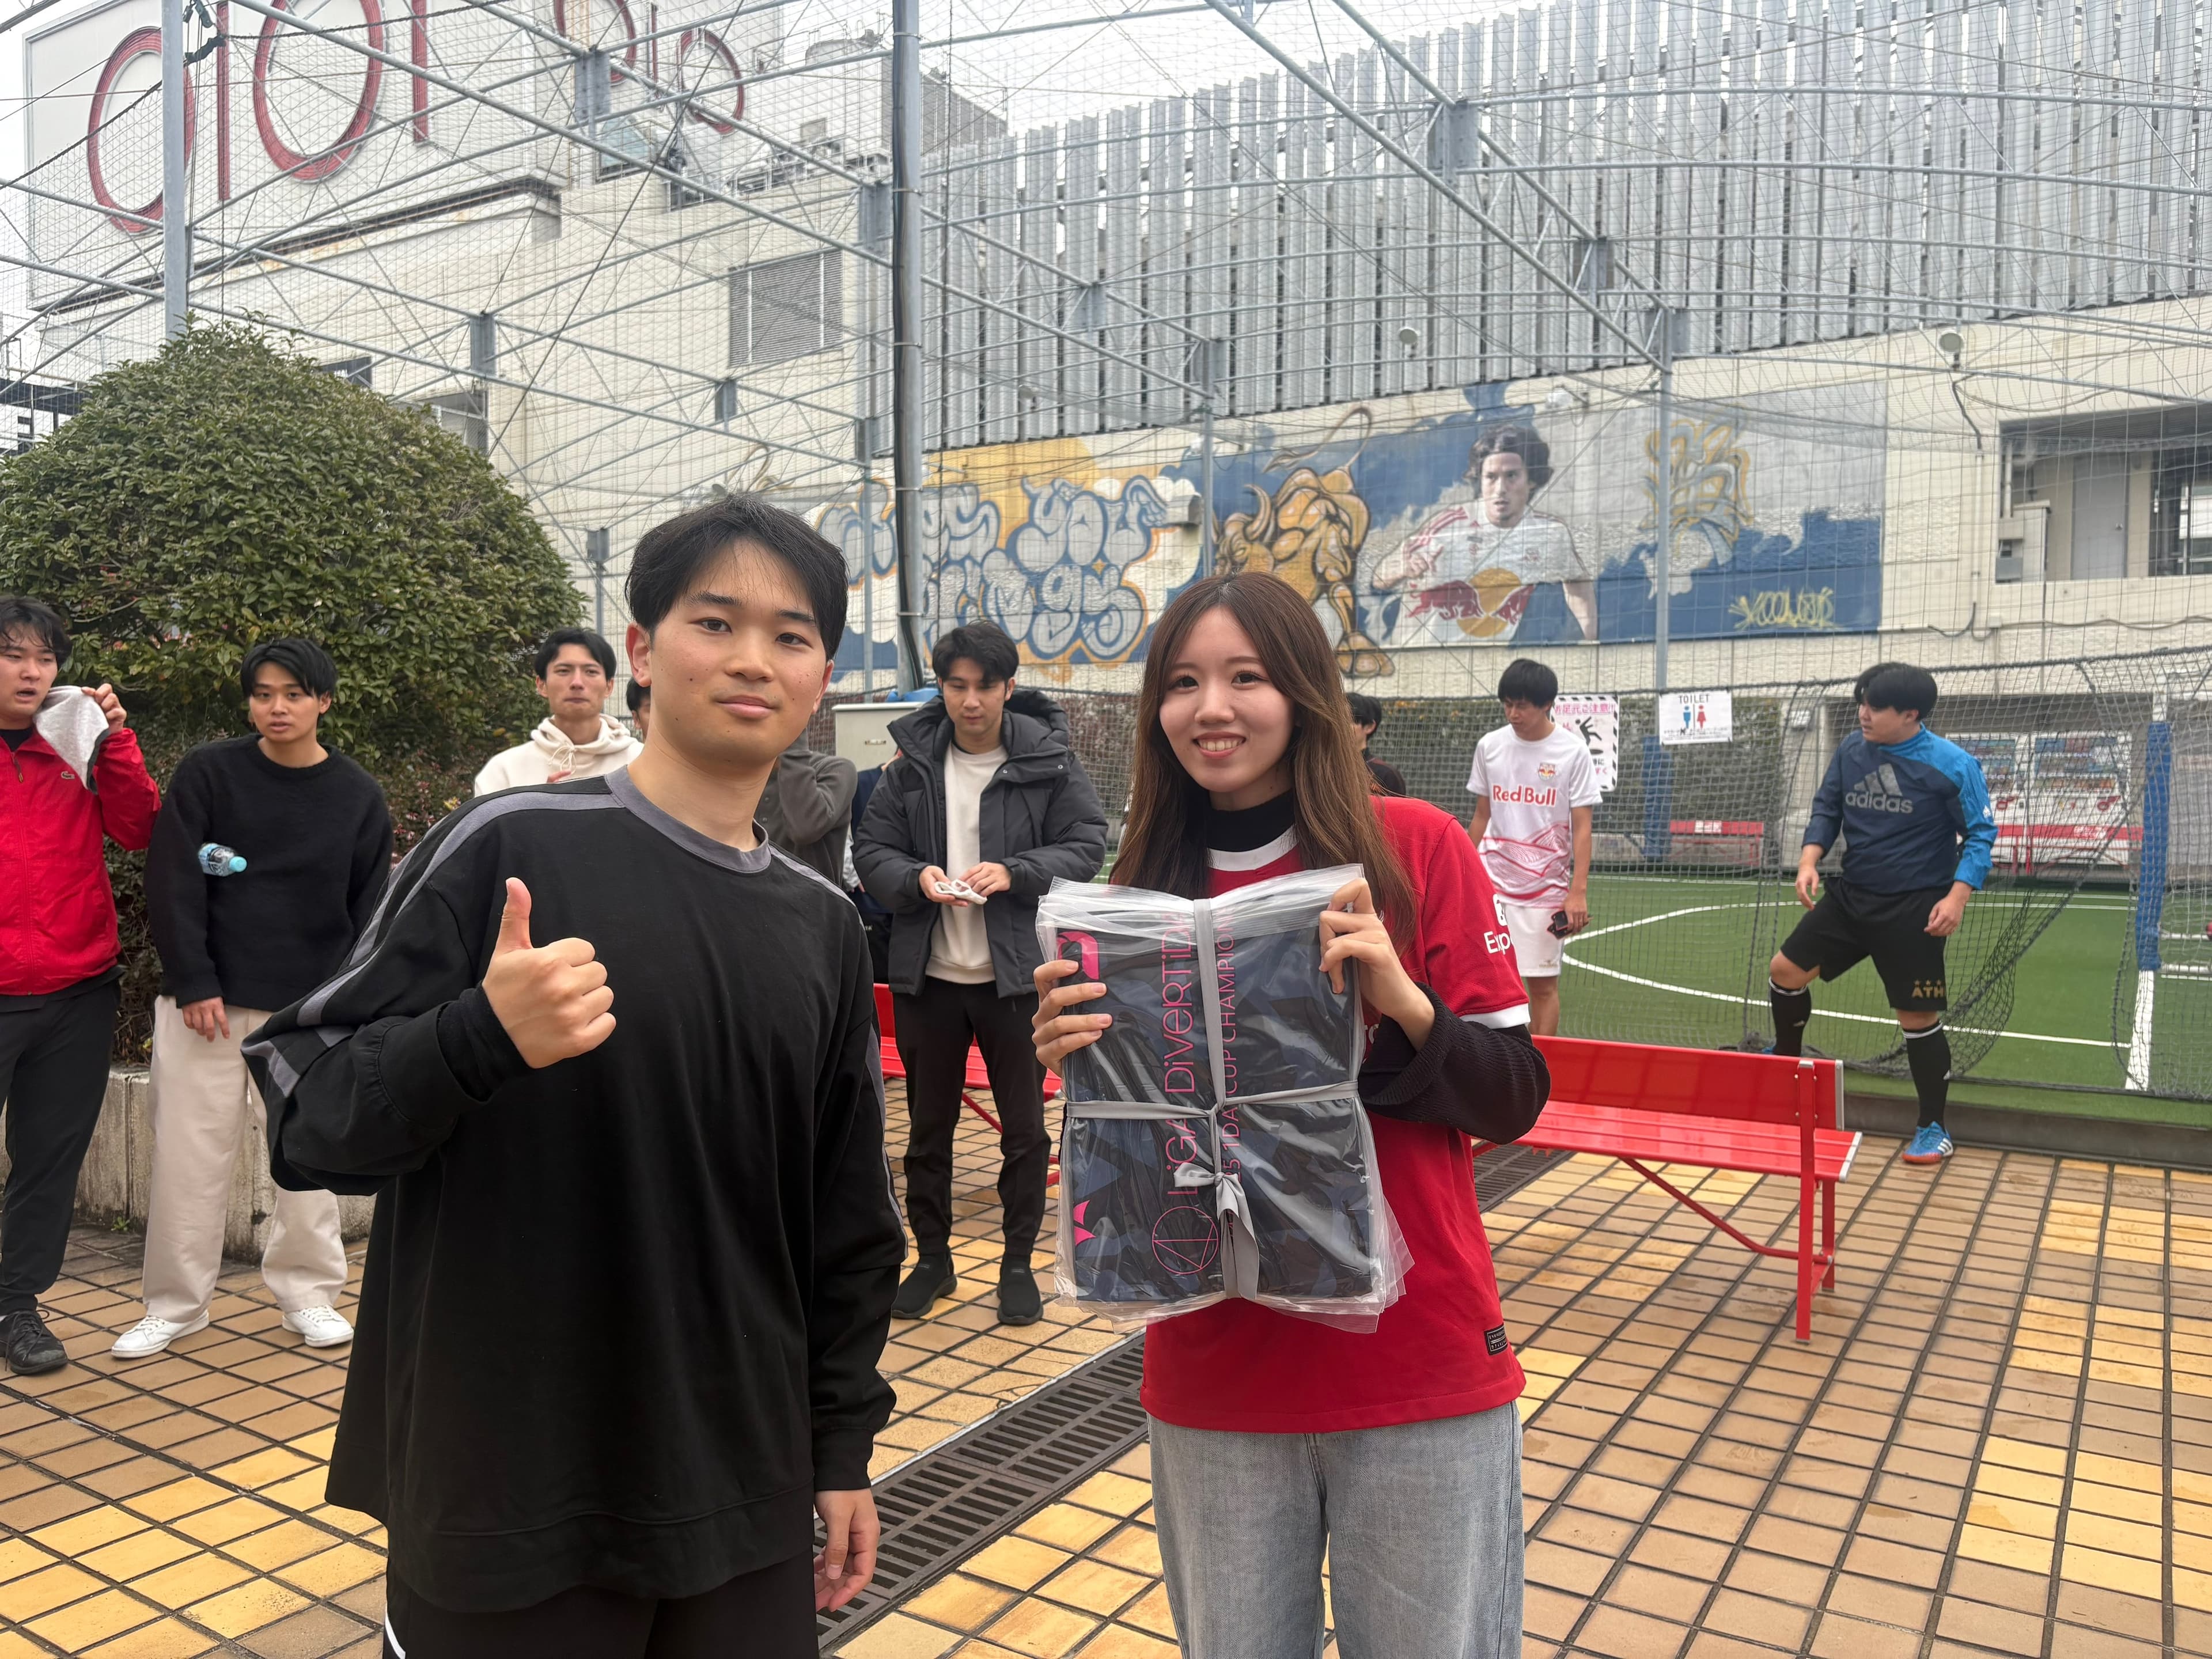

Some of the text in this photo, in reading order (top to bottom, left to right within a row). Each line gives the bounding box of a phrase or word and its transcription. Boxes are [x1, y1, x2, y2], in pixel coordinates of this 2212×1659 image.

[1679, 694, 1710, 703] TOILET
[1493, 785, 1556, 806] Red Bull
[1845, 791, 1912, 814] adidas
[1483, 930, 1513, 955] Exp
